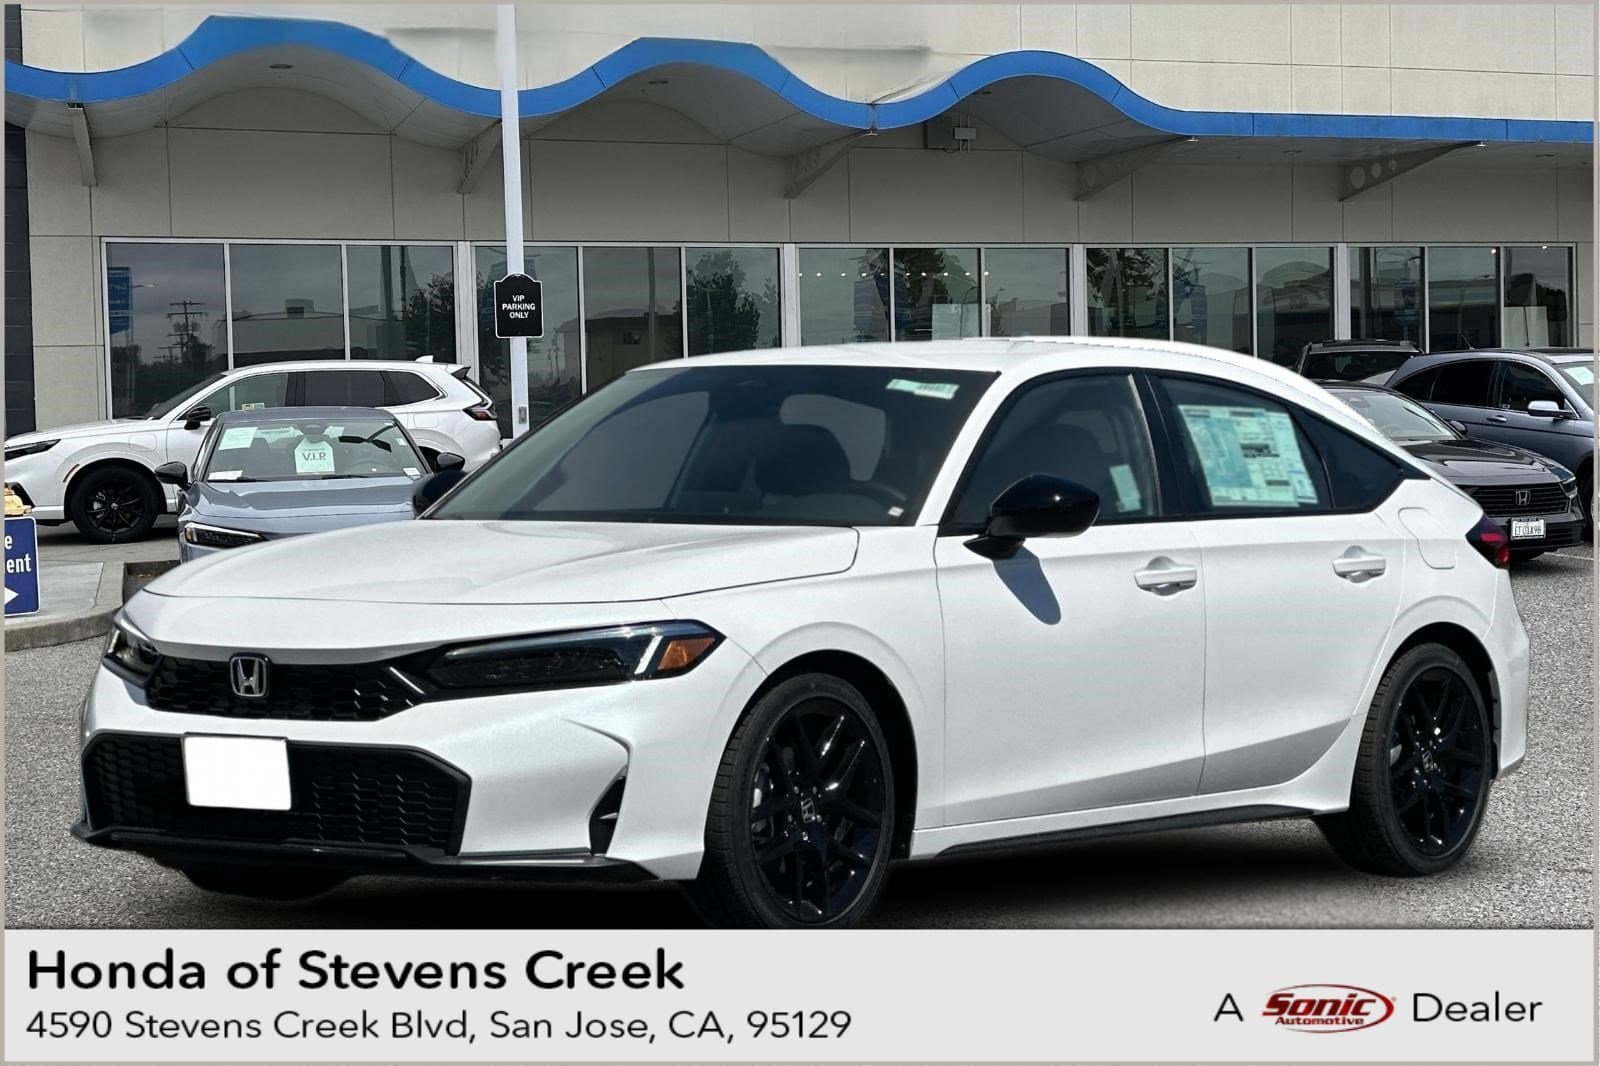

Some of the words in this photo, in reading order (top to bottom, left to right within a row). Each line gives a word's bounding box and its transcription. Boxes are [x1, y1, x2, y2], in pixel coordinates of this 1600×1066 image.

[512, 294, 525, 302] VIP
[502, 303, 536, 311] PARKING
[509, 311, 529, 319] ONLY
